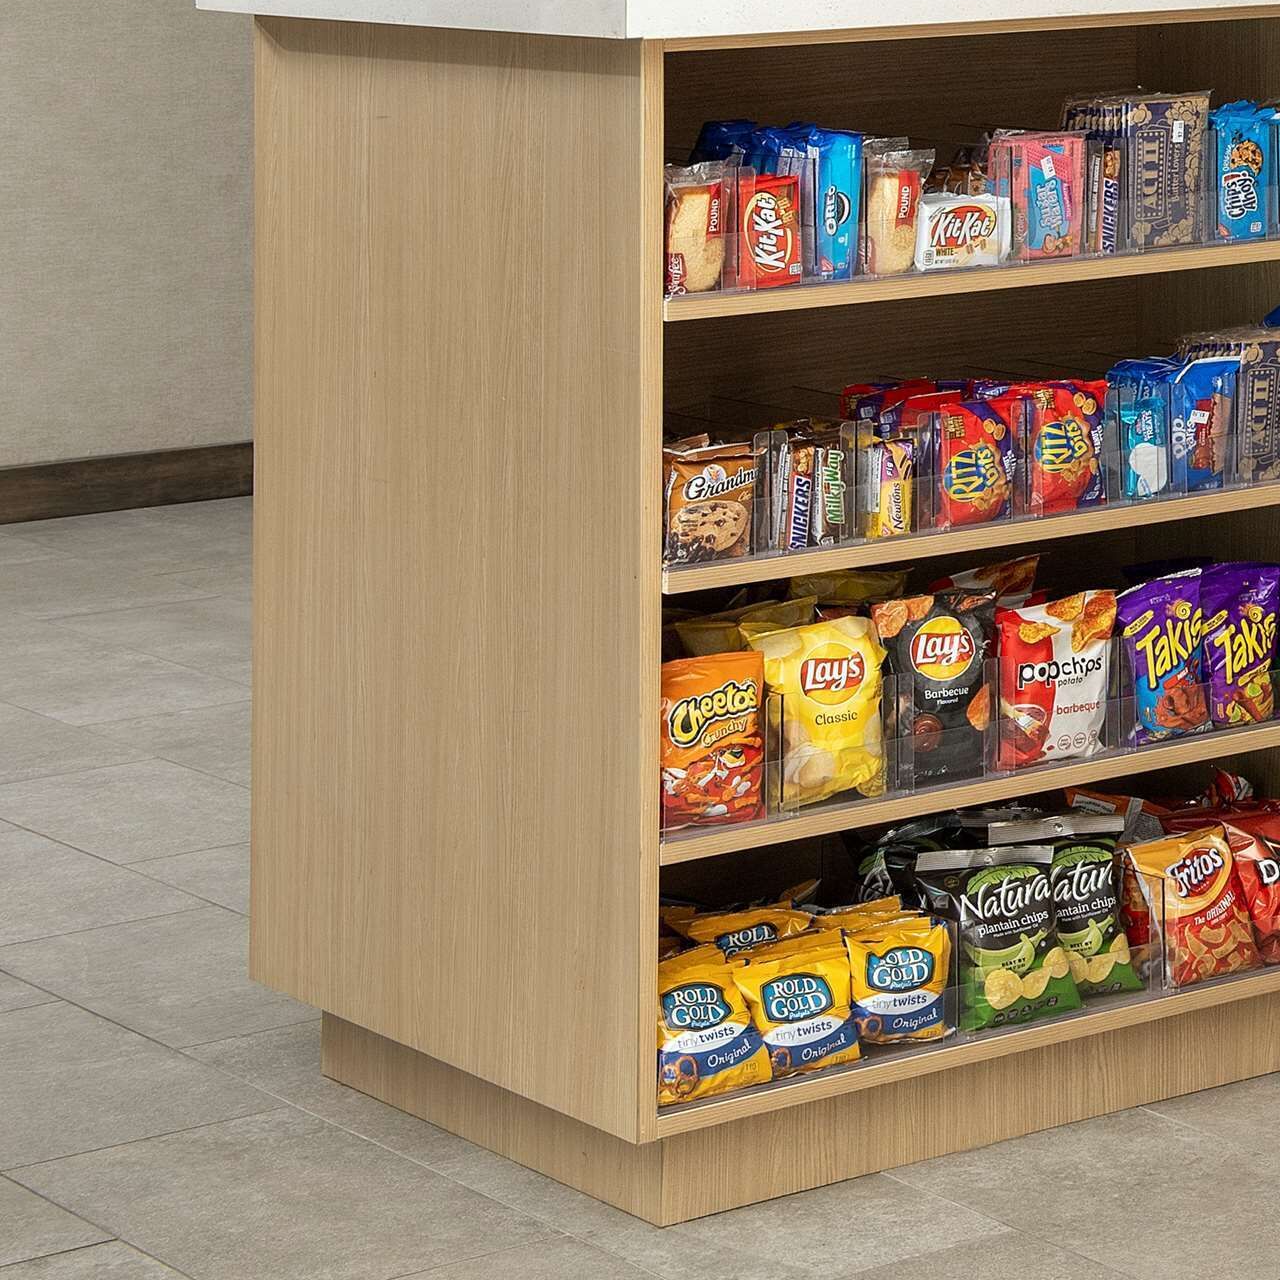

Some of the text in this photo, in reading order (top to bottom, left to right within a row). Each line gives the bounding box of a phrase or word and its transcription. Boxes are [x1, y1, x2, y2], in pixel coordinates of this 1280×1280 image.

[1146, 141, 1160, 209] ACT II
[1170, 144, 1180, 201] Butter Lovers
[708, 199, 719, 233] POUND
[824, 185, 838, 236] OREO
[898, 186, 911, 220] POUND
[1035, 184, 1052, 227] Sugar
[1046, 179, 1062, 230] Wafers
[1223, 180, 1247, 219] Chips
[1100, 180, 1118, 254] SNICKERS
[936, 247, 955, 257] WHITE
[1251, 377, 1269, 445] ACT II
[1042, 422, 1073, 473] RITZ
[1066, 419, 1089, 458] bits
[886, 461, 894, 476] Fig
[951, 451, 983, 501] RITZ
[976, 447, 999, 488] bits
[790, 477, 811, 550] SNICKERS
[893, 482, 905, 530] Newtons
[915, 629, 972, 671] Lay's
[1135, 607, 1203, 689] Takis
[1213, 612, 1277, 685] Takis
[804, 653, 863, 692] Lay's
[1018, 656, 1104, 689] popchips
[1057, 676, 1083, 688] potato
[924, 686, 969, 700] Barbecue
[1056, 701, 1101, 715] barbeque
[668, 680, 759, 748] Cheetos
[815, 710, 858, 726] Classic
[701, 718, 747, 747] Crunchy
[1166, 847, 1223, 898] Fritos
[1090, 896, 1117, 910] chips
[1194, 892, 1236, 926] The ORIGINAL
[978, 910, 1049, 938] plantain chips
[768, 975, 819, 999] ROLD
[872, 963, 930, 987] GOLD
[671, 988, 717, 1008] ROLD
[770, 991, 827, 1018] GOLD
[871, 993, 928, 1011] tiny twists
[671, 1004, 725, 1028] GOLD
[775, 1021, 834, 1043] tiny twists
[892, 1008, 939, 1029] Original
[678, 1026, 736, 1050] tiny twists
[707, 1041, 751, 1068] Original
[801, 1034, 847, 1061] Original
